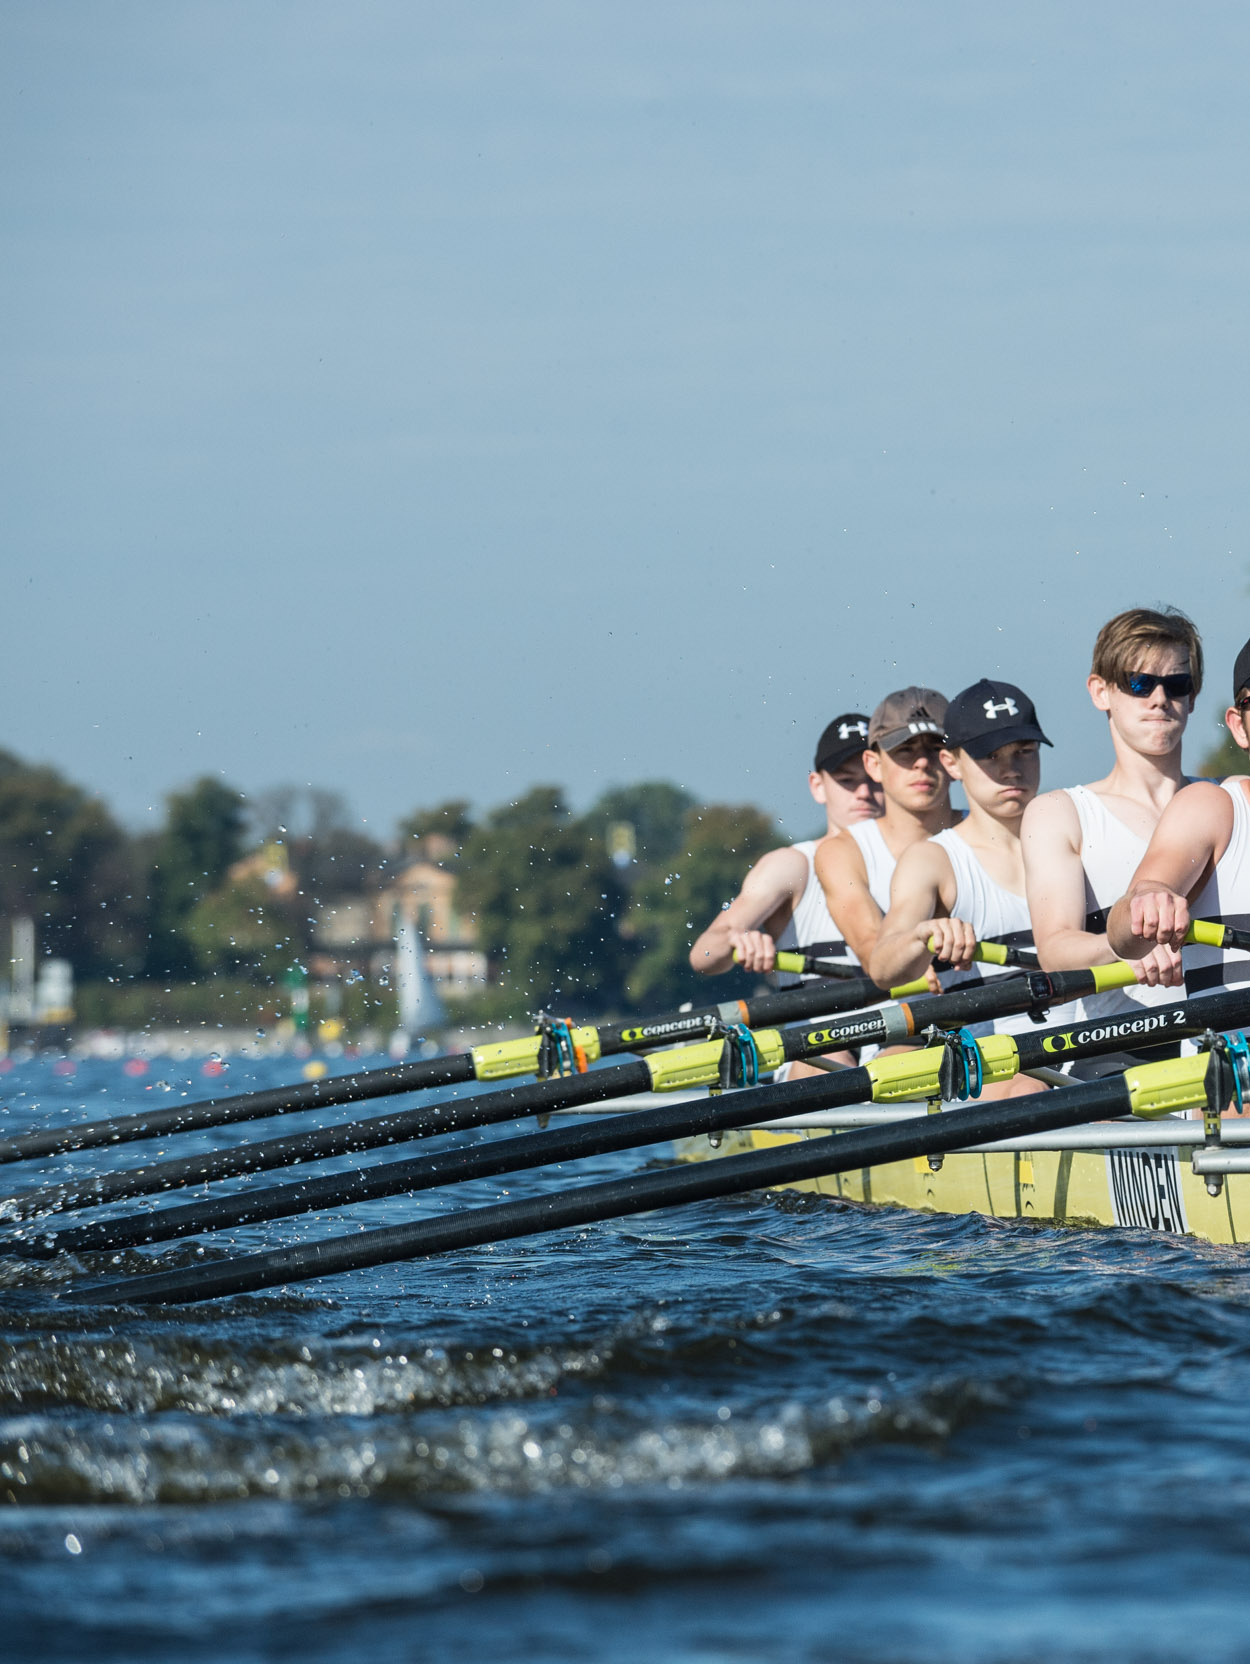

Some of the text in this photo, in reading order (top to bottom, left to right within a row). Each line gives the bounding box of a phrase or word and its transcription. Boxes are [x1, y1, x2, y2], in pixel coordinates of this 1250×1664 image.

[642, 1016, 702, 1036] concept
[830, 1018, 887, 1039] concep
[1077, 1010, 1187, 1044] concept 2
[1109, 1150, 1185, 1234] MINDEN
